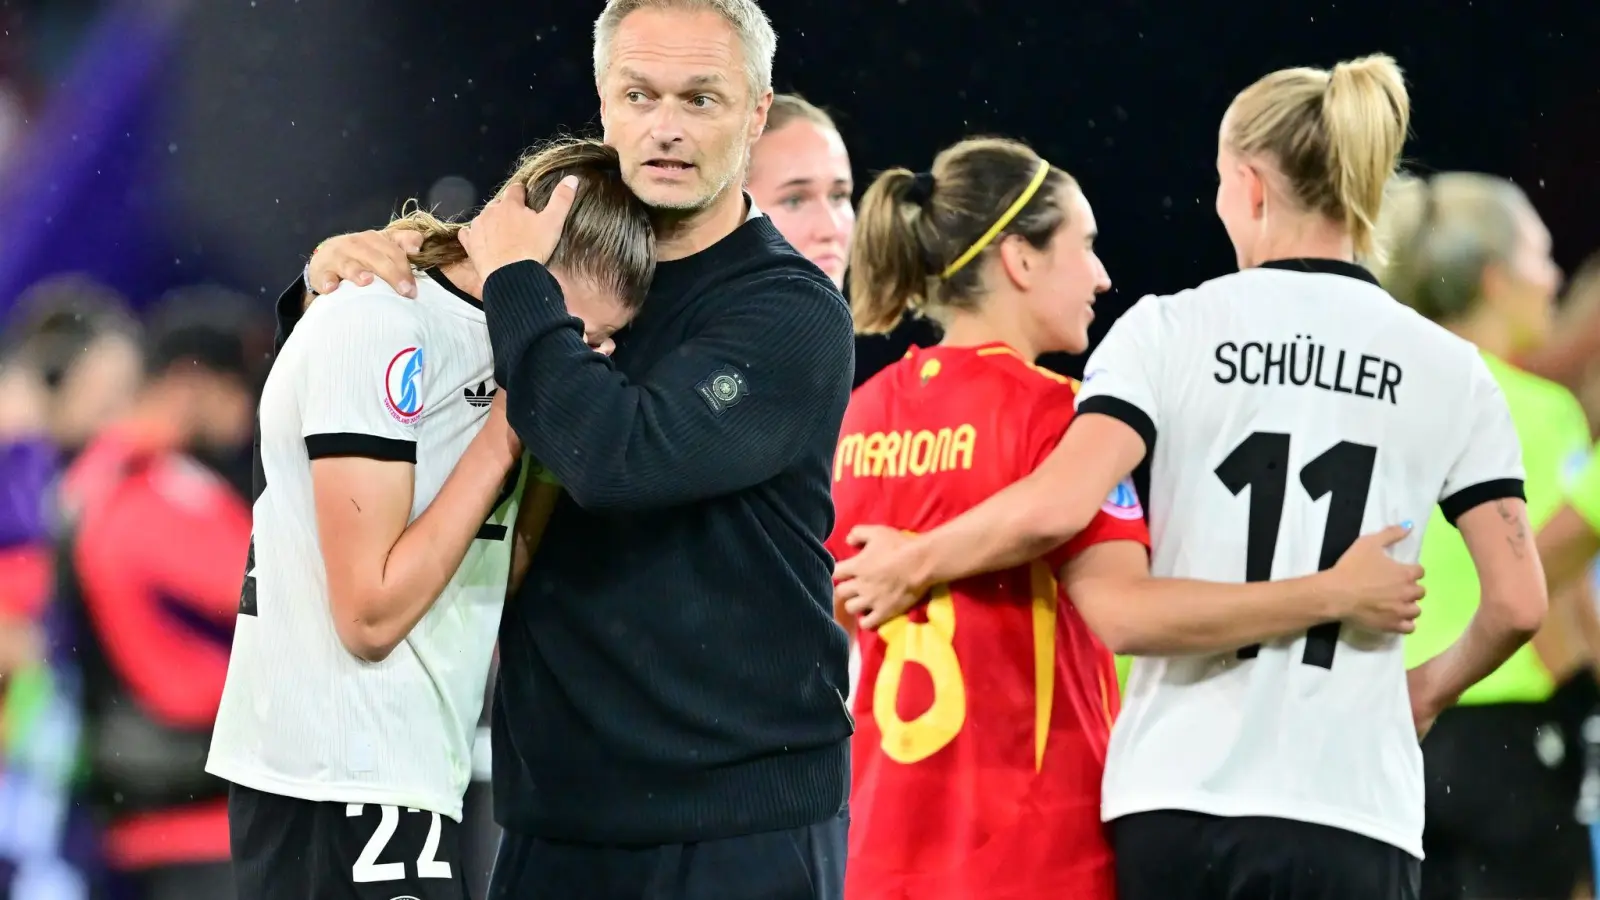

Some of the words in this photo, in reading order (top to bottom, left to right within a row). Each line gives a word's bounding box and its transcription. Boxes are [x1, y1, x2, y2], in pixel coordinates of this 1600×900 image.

[1213, 334, 1404, 405] SCHÜLLER
[834, 423, 976, 482] MARIONA
[1213, 431, 1378, 671] 11
[872, 529, 966, 764] 8
[345, 803, 453, 883] 22
